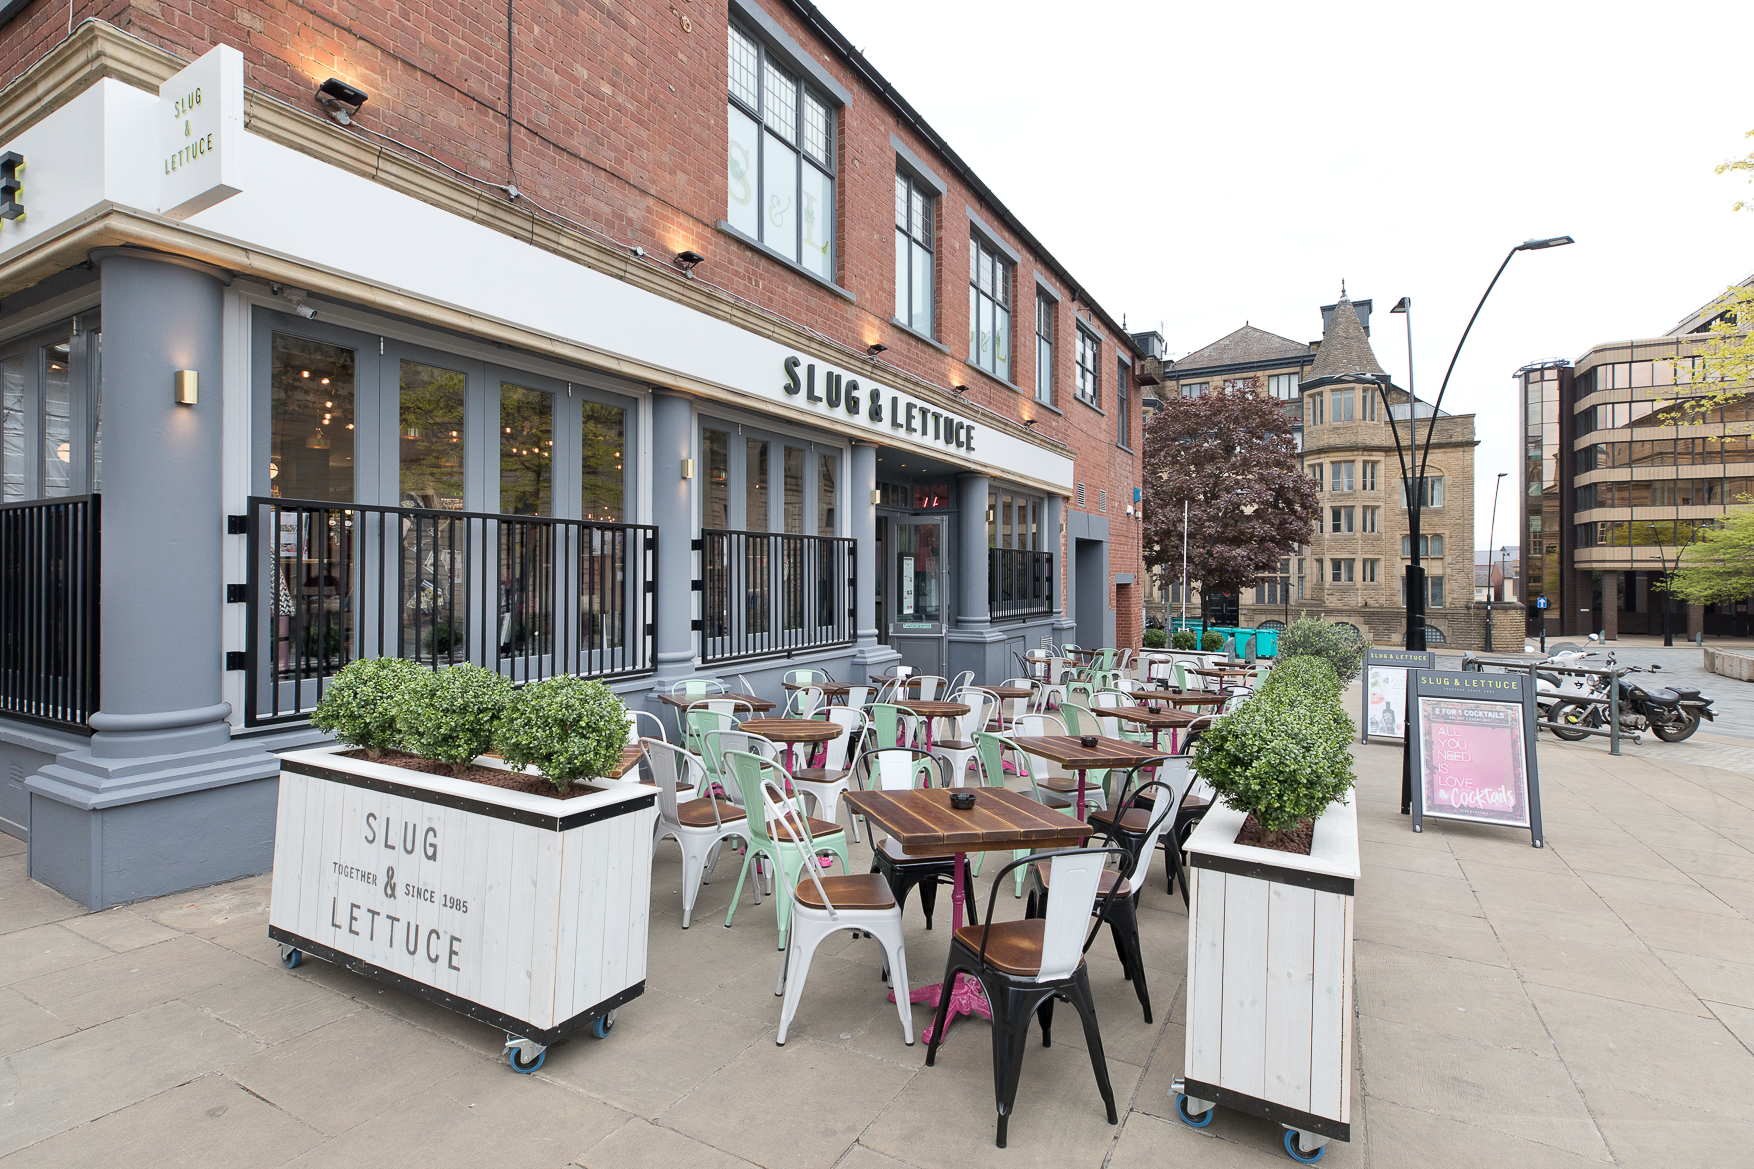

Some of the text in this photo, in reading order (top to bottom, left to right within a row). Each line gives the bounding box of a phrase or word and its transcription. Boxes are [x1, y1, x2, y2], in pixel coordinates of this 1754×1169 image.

[175, 88, 201, 118] SLUG
[185, 120, 191, 137] &
[165, 133, 213, 175] LETTUCE
[769, 195, 791, 227] &
[784, 356, 975, 451] SLUG & LETTUCE
[1421, 677, 1449, 685] SLUG
[1465, 679, 1517, 689] LETTUCE
[1464, 710, 1504, 718] COCKTAILS
[1438, 727, 1461, 736] ALL
[1438, 739, 1467, 749] YOU
[1438, 750, 1471, 761] NEED
[1439, 763, 1448, 774] IS
[1439, 776, 1473, 788] LOVE
[1451, 785, 1514, 809] Cocktails
[365, 812, 438, 862] SLUG
[333, 862, 468, 913] TOGETHER & SINCE 1985
[331, 897, 462, 972] LETTUCE
